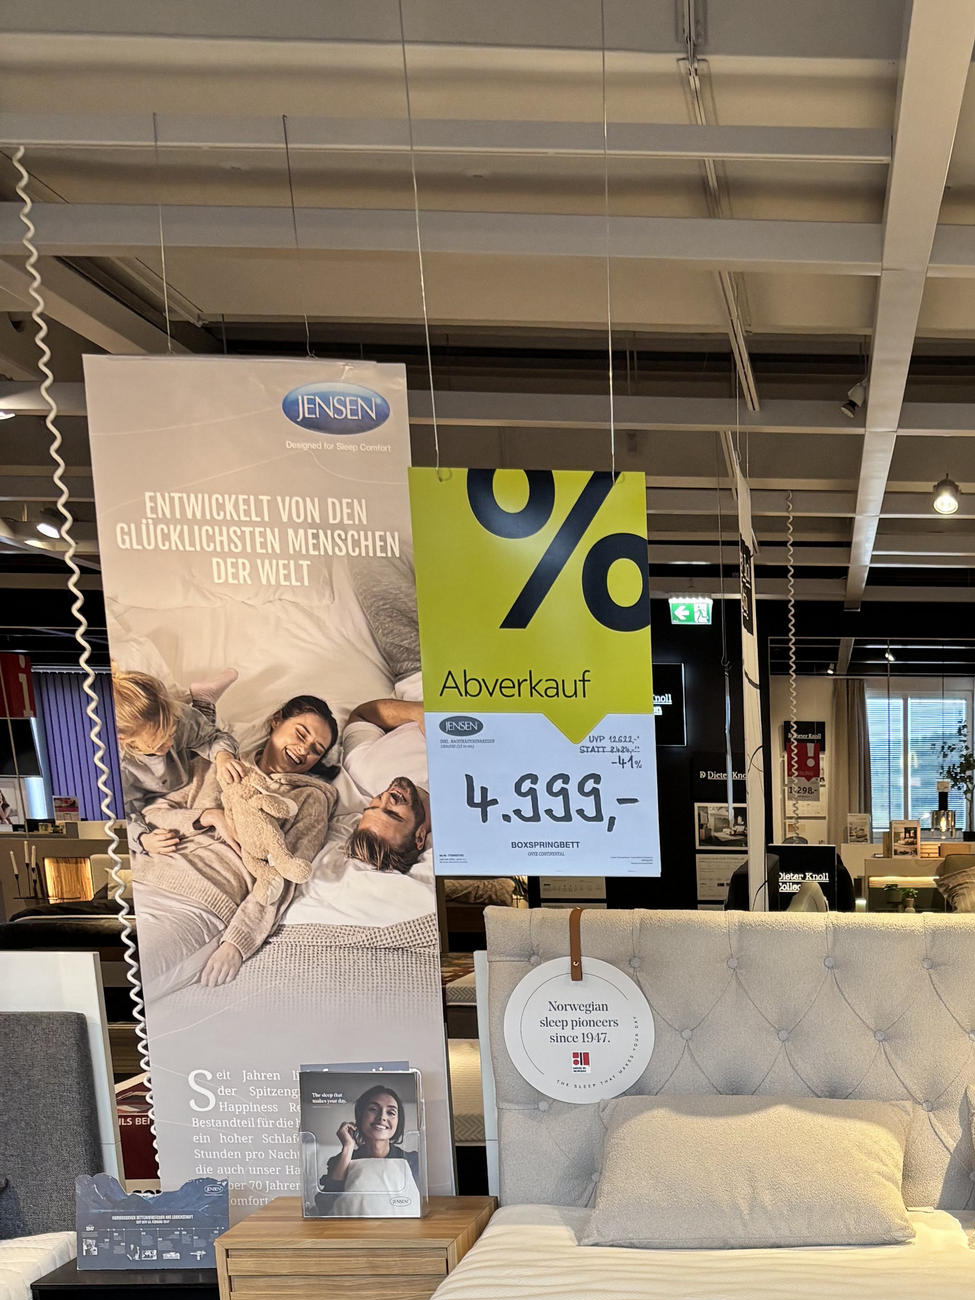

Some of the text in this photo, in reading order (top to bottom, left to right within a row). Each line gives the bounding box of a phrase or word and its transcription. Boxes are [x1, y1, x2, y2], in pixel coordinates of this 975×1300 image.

[297, 395, 376, 421] JENSEN
[286, 440, 392, 452] Designed for Sleep Comfort
[144, 492, 367, 525] ENTWICKELT VON DEN
[115, 520, 400, 557] GLÜCKLICHSTEN MENSCHEN
[212, 558, 311, 586] DER WELT
[439, 669, 592, 699] Abverkauf
[653, 693, 672, 704] noll
[445, 721, 478, 732] JENSEN
[588, 735, 605, 744] UVP
[579, 745, 607, 754] STATT
[611, 755, 643, 769] -41%
[707, 770, 728, 780] Diete
[464, 773, 640, 832] 4.999,-
[510, 841, 581, 849] BOXSPRINGBETT
[805, 872, 829, 881] Knoll
[548, 1000, 609, 1014] Norwegian
[539, 1016, 619, 1030] sleep pioneers
[549, 1032, 611, 1043] since 1947.
[242, 1070, 281, 1083] Jahren
[218, 1086, 237, 1097] der
[219, 1102, 279, 1117] Happiness
[192, 1117, 294, 1128] Bestandteil für die
[193, 1133, 211, 1144] ein
[220, 1133, 253, 1144] hoher
[194, 1149, 242, 1160] Stunden
[245, 1151, 265, 1162] pro
[195, 1165, 213, 1175] die
[217, 1165, 245, 1175] auch
[248, 1167, 281, 1176] unser
[229, 1181, 247, 1190] ber
[249, 1180, 263, 1190] 70
[231, 1196, 270, 1206] omfort
